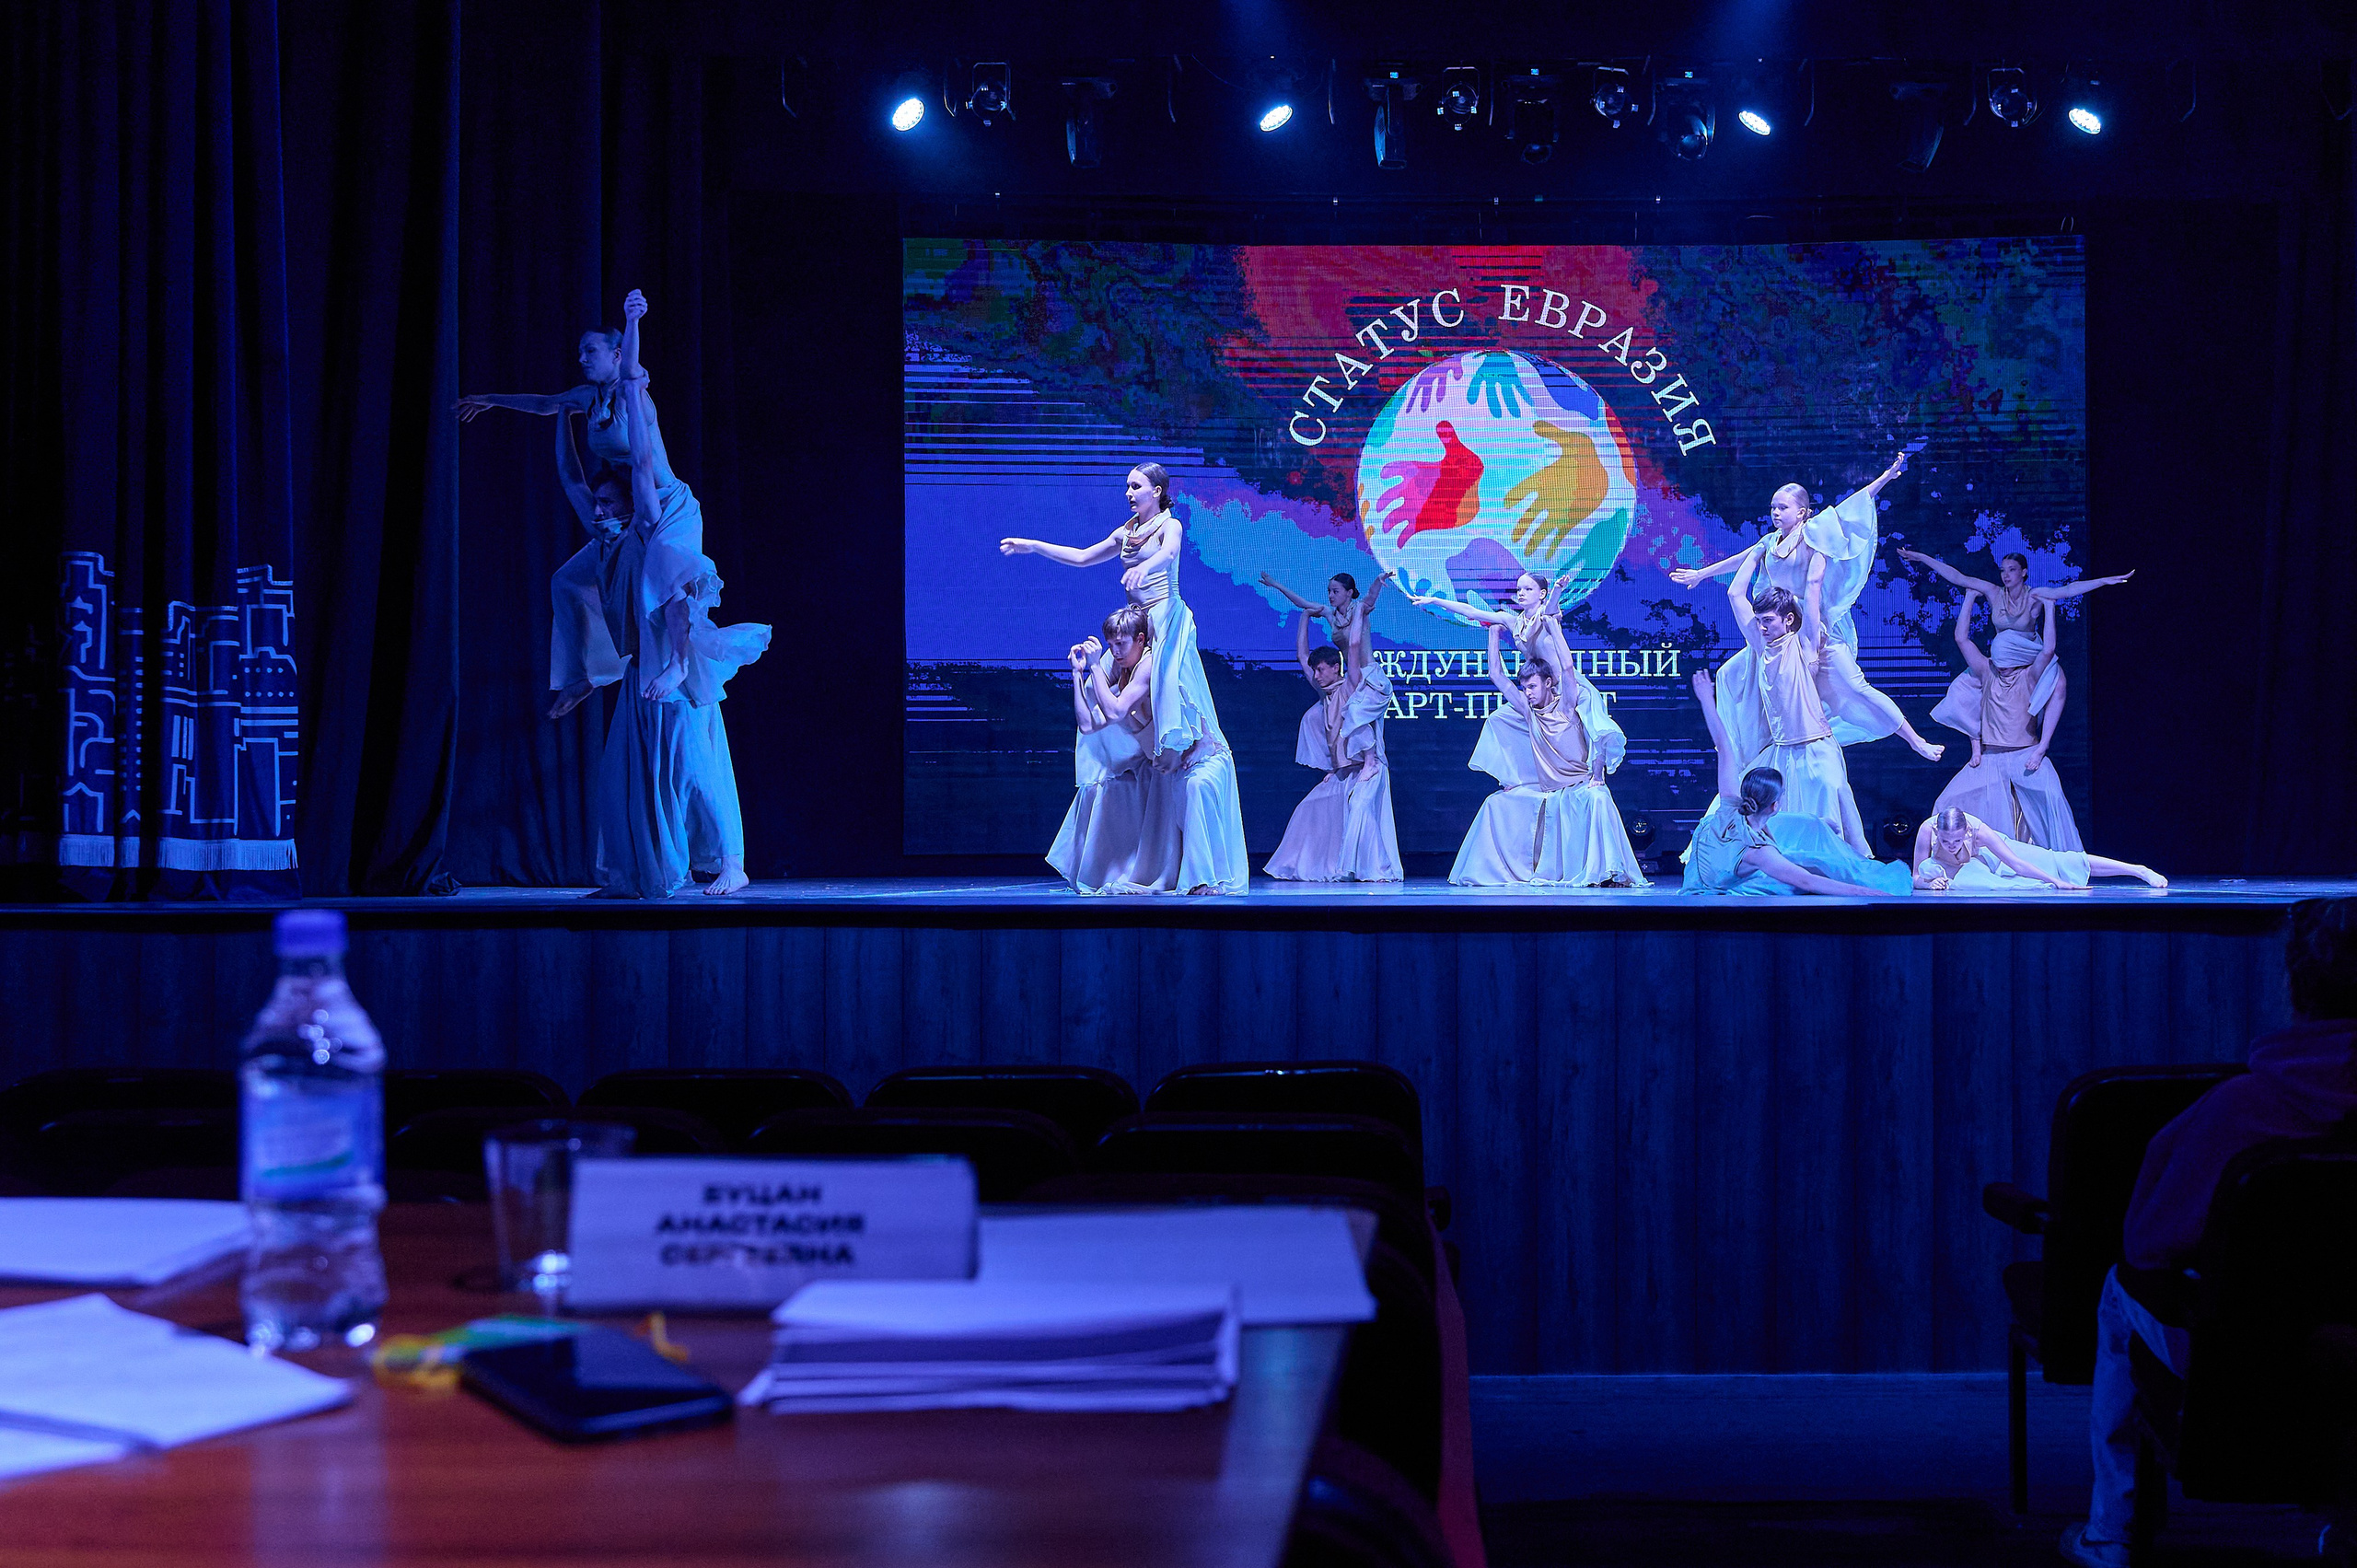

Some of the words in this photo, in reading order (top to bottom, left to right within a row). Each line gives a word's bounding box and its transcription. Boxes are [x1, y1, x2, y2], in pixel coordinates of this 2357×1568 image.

[1289, 287, 1464, 447] СТАТУС
[1498, 284, 1716, 457] ЕВРАЗИЯ
[1383, 691, 1617, 719] АРТ-ПТ
[656, 1213, 865, 1234] АНАСТАСИЯ
